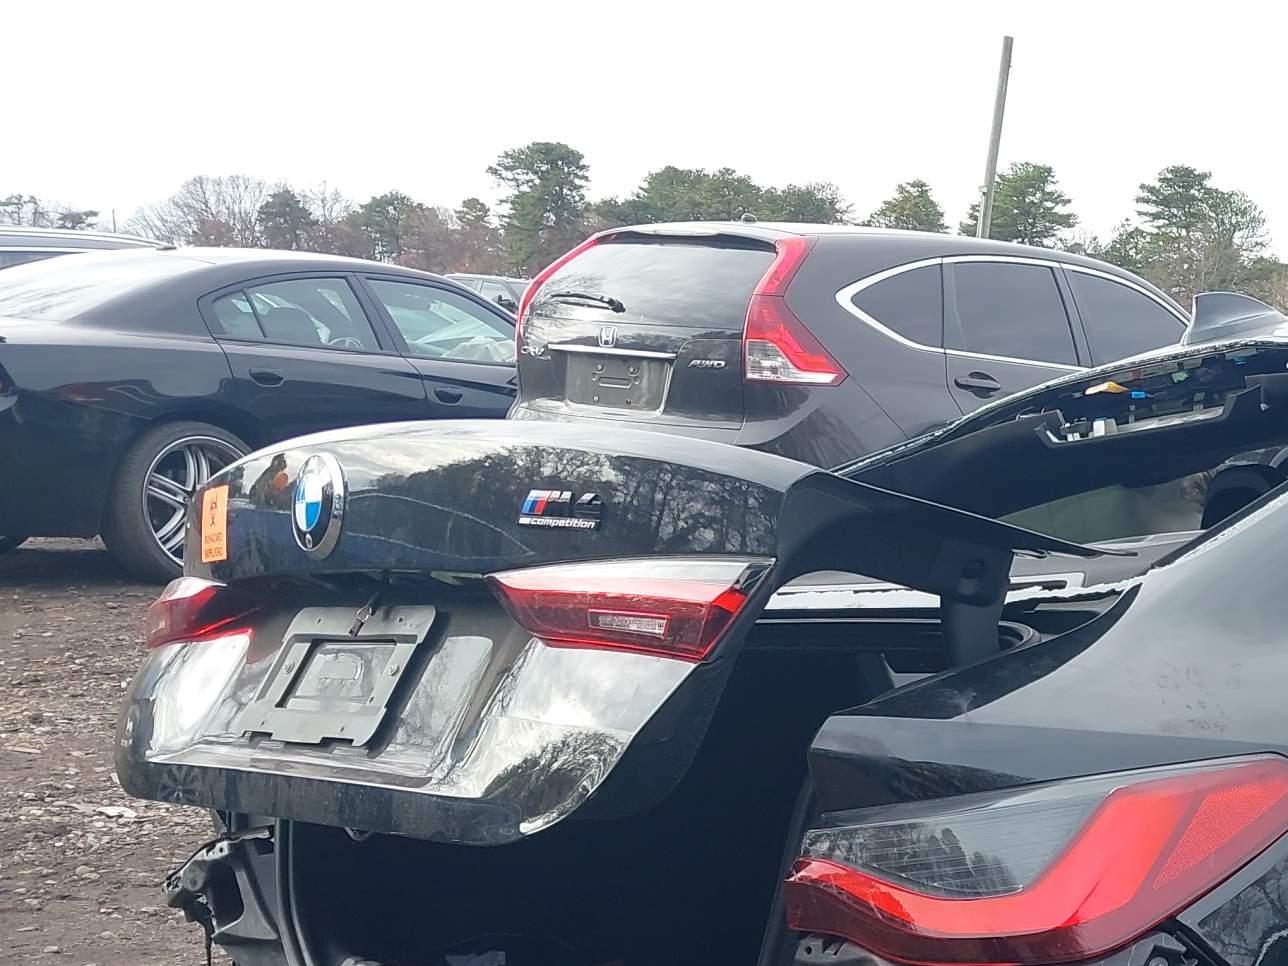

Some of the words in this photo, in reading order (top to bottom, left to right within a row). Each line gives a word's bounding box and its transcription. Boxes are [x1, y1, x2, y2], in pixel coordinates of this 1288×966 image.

[687, 359, 727, 369] AWD
[522, 489, 602, 519] M4
[530, 517, 597, 530] competition
